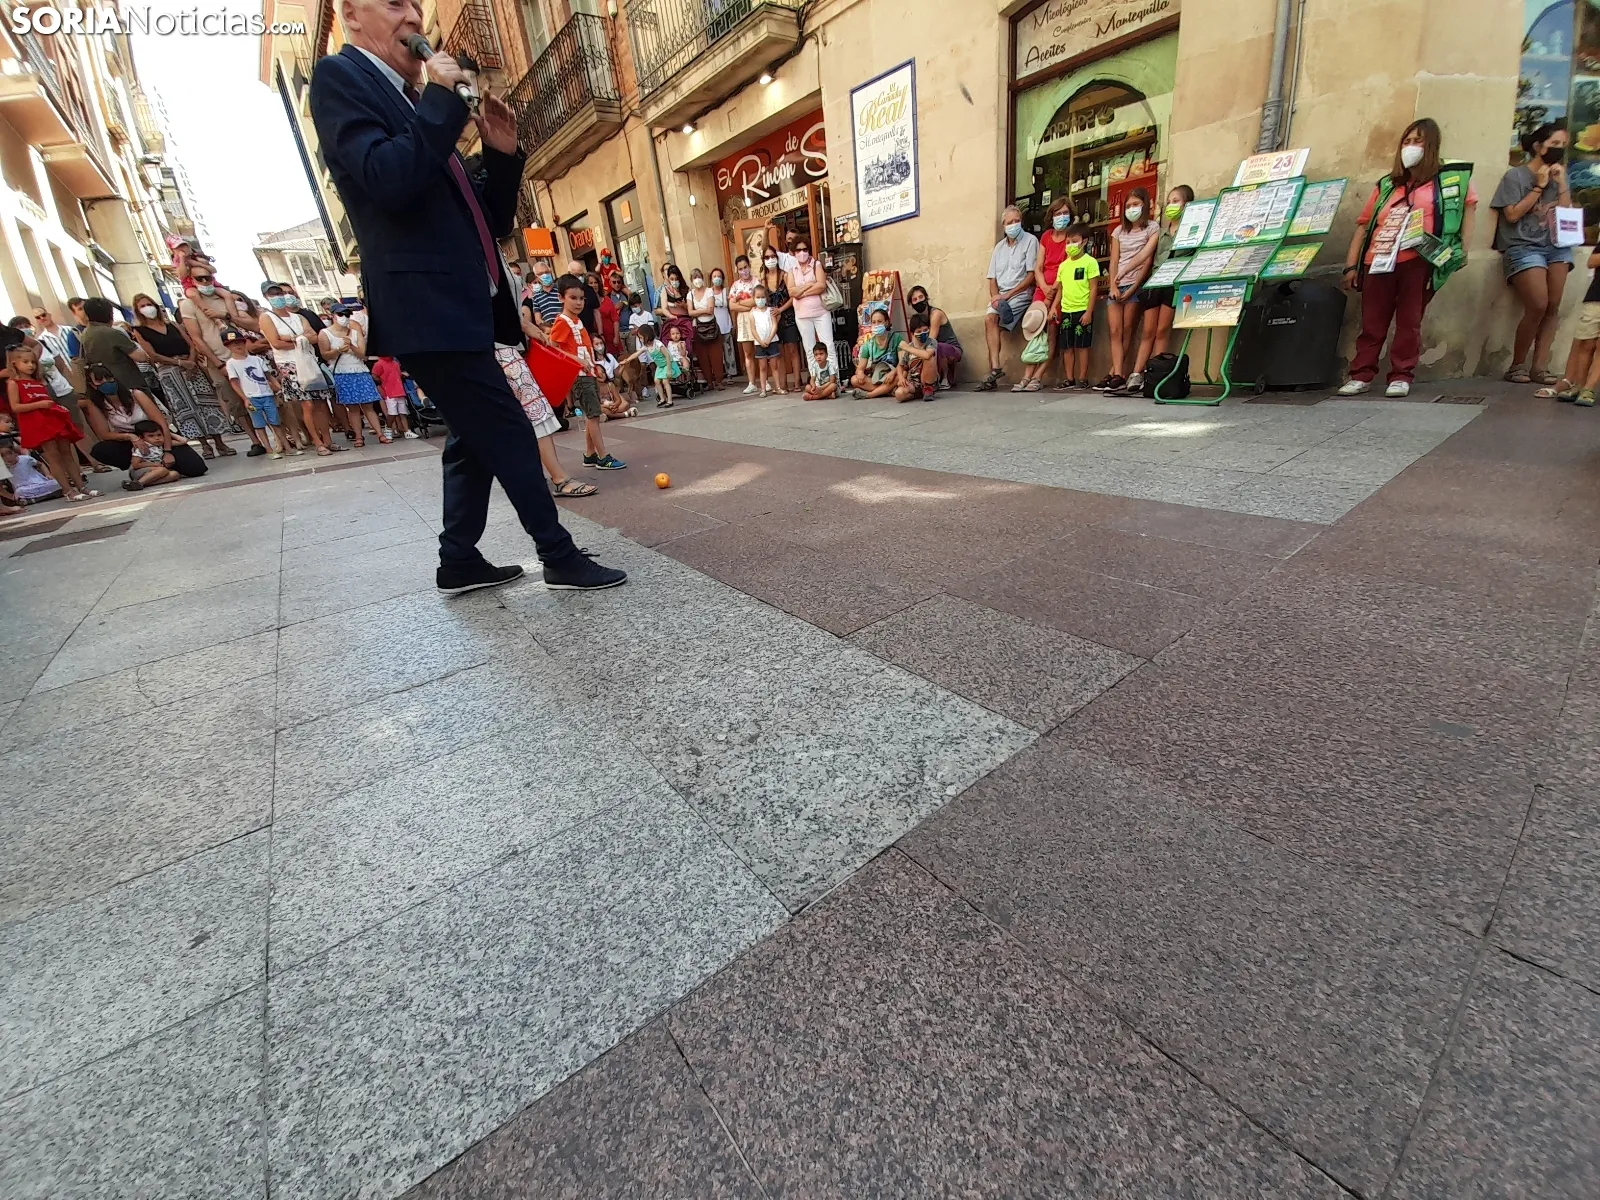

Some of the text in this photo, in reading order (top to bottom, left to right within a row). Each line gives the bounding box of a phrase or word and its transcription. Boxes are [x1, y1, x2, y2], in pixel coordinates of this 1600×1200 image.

[1095, 0, 1170, 38] Mantequilla
[1024, 42, 1066, 67] Aceites
[858, 84, 908, 136] Real
[717, 167, 731, 190] El
[732, 153, 796, 200] Rincón
[785, 131, 798, 152] de
[1272, 155, 1293, 170] 23
[751, 197, 788, 219] PRODUCTO
